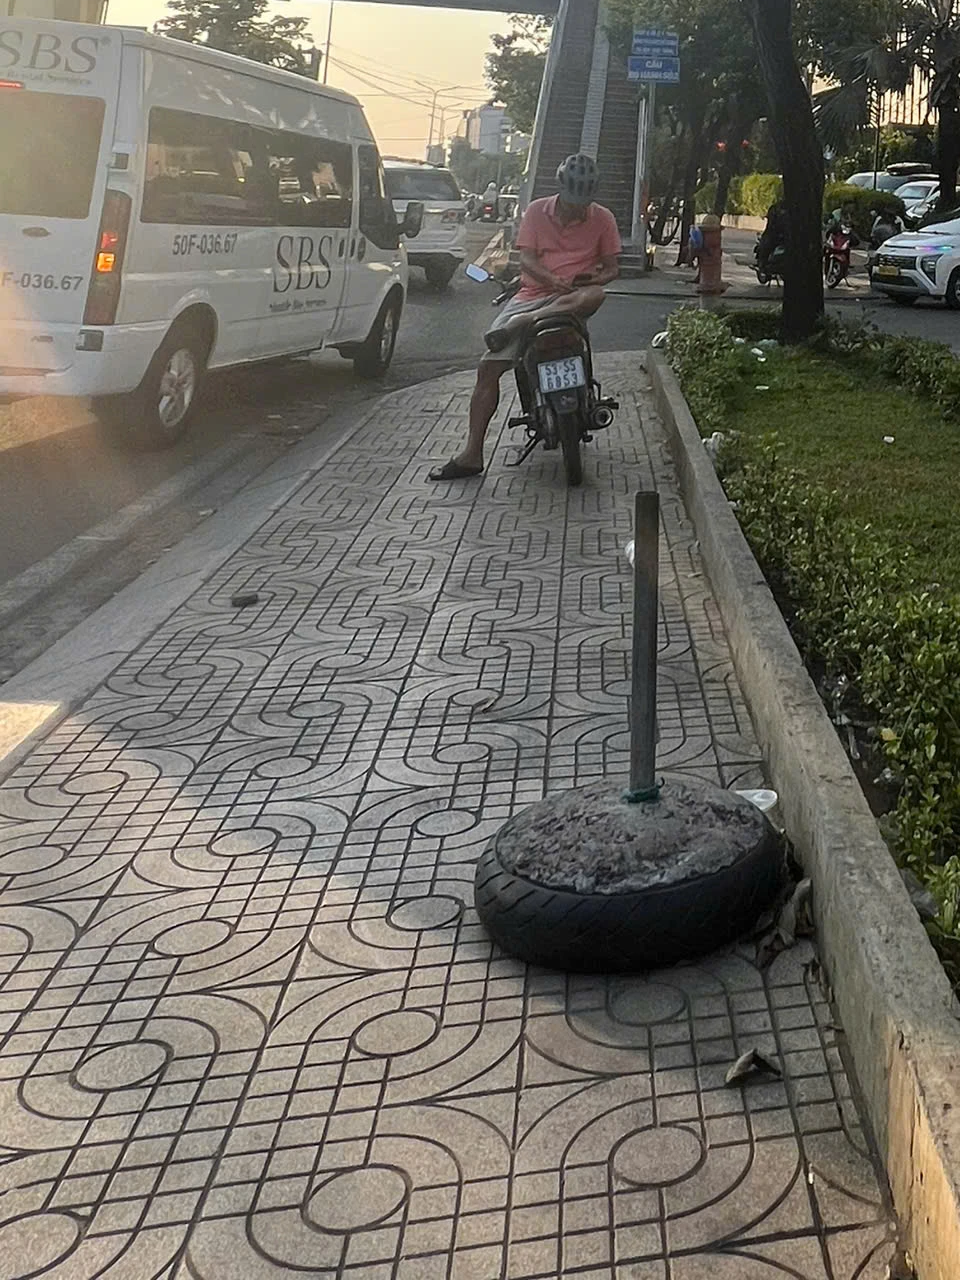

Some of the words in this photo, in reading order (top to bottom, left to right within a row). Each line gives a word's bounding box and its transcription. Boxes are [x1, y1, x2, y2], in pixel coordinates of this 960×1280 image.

[0, 30, 99, 74] SBS
[172, 232, 239, 256] 50F-036.67
[273, 234, 333, 294] SBS
